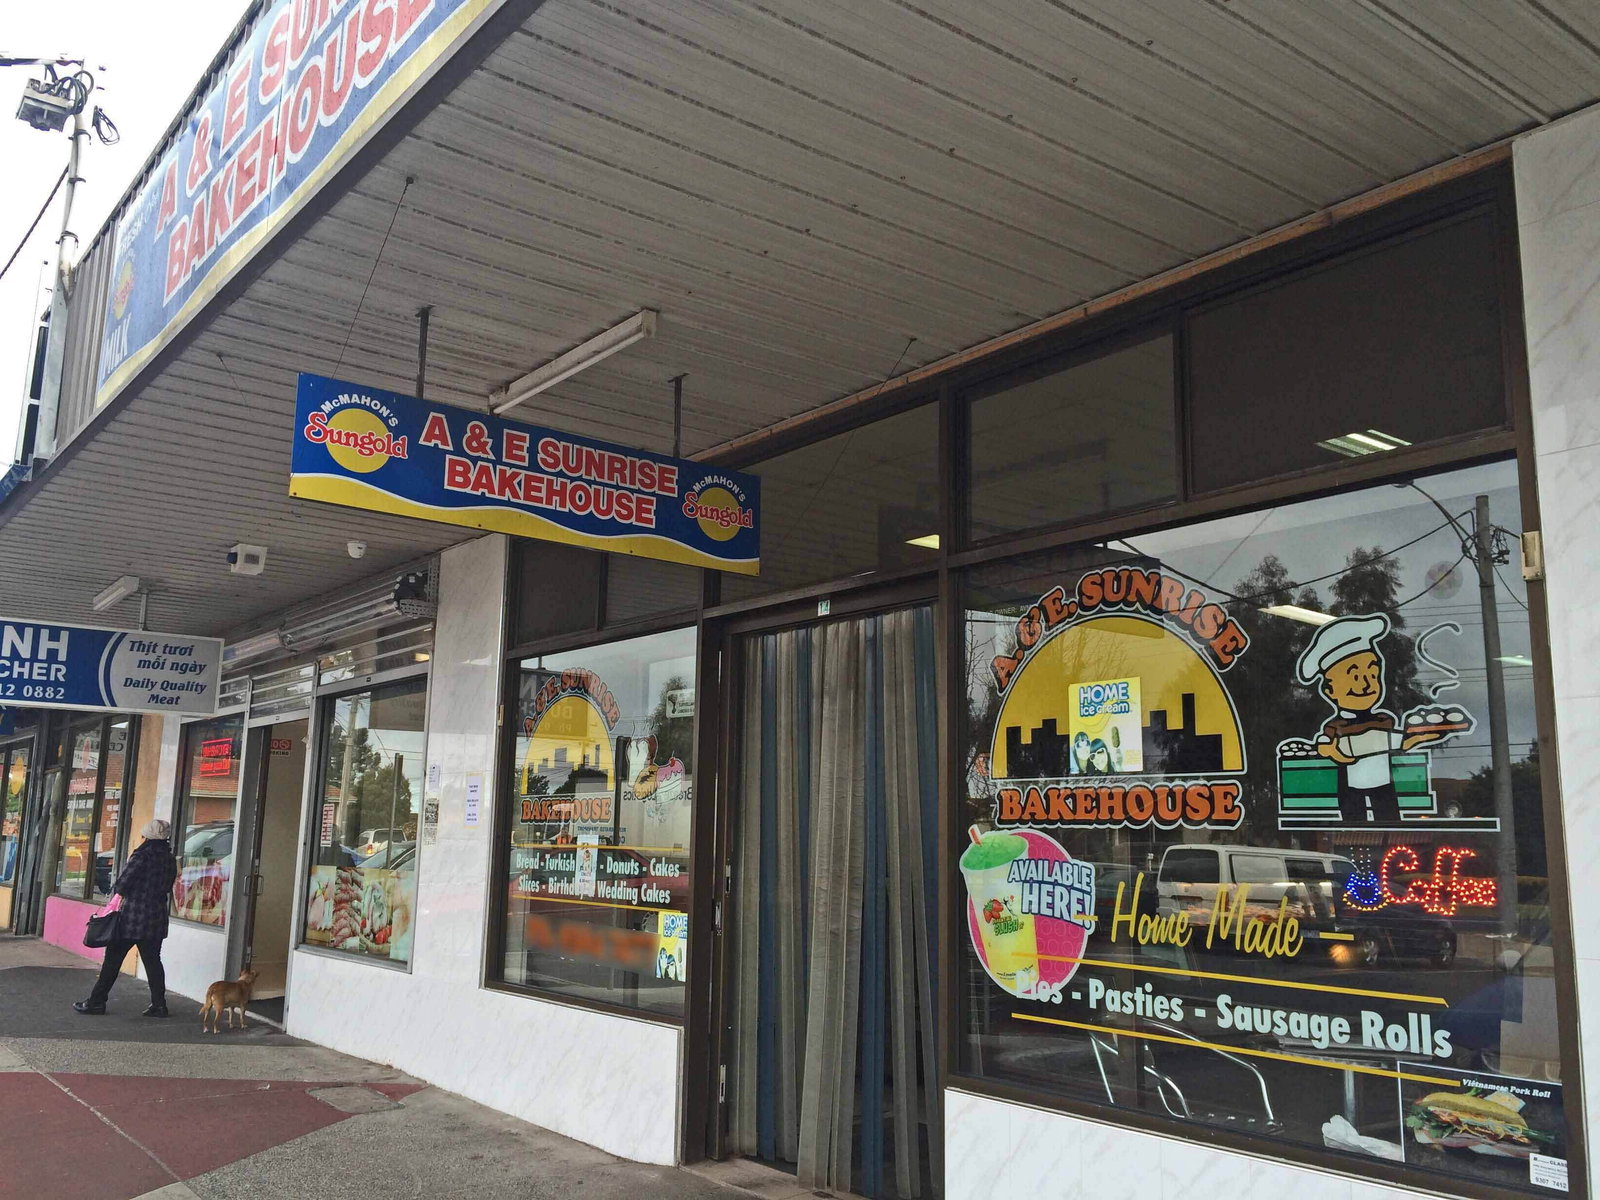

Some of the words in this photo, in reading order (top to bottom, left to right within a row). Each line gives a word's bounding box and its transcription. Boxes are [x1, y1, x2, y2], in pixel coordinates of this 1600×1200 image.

[155, 156, 179, 243] A
[186, 113, 213, 199] &
[219, 48, 254, 161] E
[320, 393, 399, 427] McMAHON'S
[304, 411, 408, 460] Sungold
[419, 412, 452, 451] A
[462, 421, 494, 460] &
[502, 429, 529, 465] E
[537, 437, 679, 496] SUNRISE
[444, 456, 657, 529] BAKEHOUSE
[682, 491, 753, 529] Sungold
[1079, 567, 1249, 668] SUNRISE
[1, 624, 69, 662] NH
[23, 684, 65, 700] 0882
[123, 677, 157, 691] Daily
[160, 680, 208, 695] Quality
[148, 693, 181, 706] Meat
[561, 668, 620, 732] SUNRISE
[1078, 681, 1131, 704] HOME
[1079, 702, 1096, 718] ice
[1097, 700, 1130, 714] cream
[521, 799, 613, 823] BAKEHOUSE
[999, 784, 1243, 826] BAKEHOUSE
[516, 853, 540, 870] Bread
[545, 853, 576, 872] Turkish
[606, 857, 639, 875] Donuts
[650, 857, 681, 878] Cakes
[1008, 860, 1093, 892] AVAILABLE
[518, 877, 540, 893] Slices
[598, 881, 638, 905] Wedding
[641, 883, 671, 905] Cakes
[1022, 882, 1093, 929] HERE!
[663, 914, 688, 929] HOME
[1111, 872, 1193, 947] Home
[1206, 883, 1304, 959] Made
[1088, 978, 1184, 1022] Pasties
[1217, 993, 1351, 1050] Sausage
[1361, 1009, 1454, 1059] Rolls
[1510, 1085, 1531, 1096] Pork
[1532, 1089, 1552, 1099] Roll
